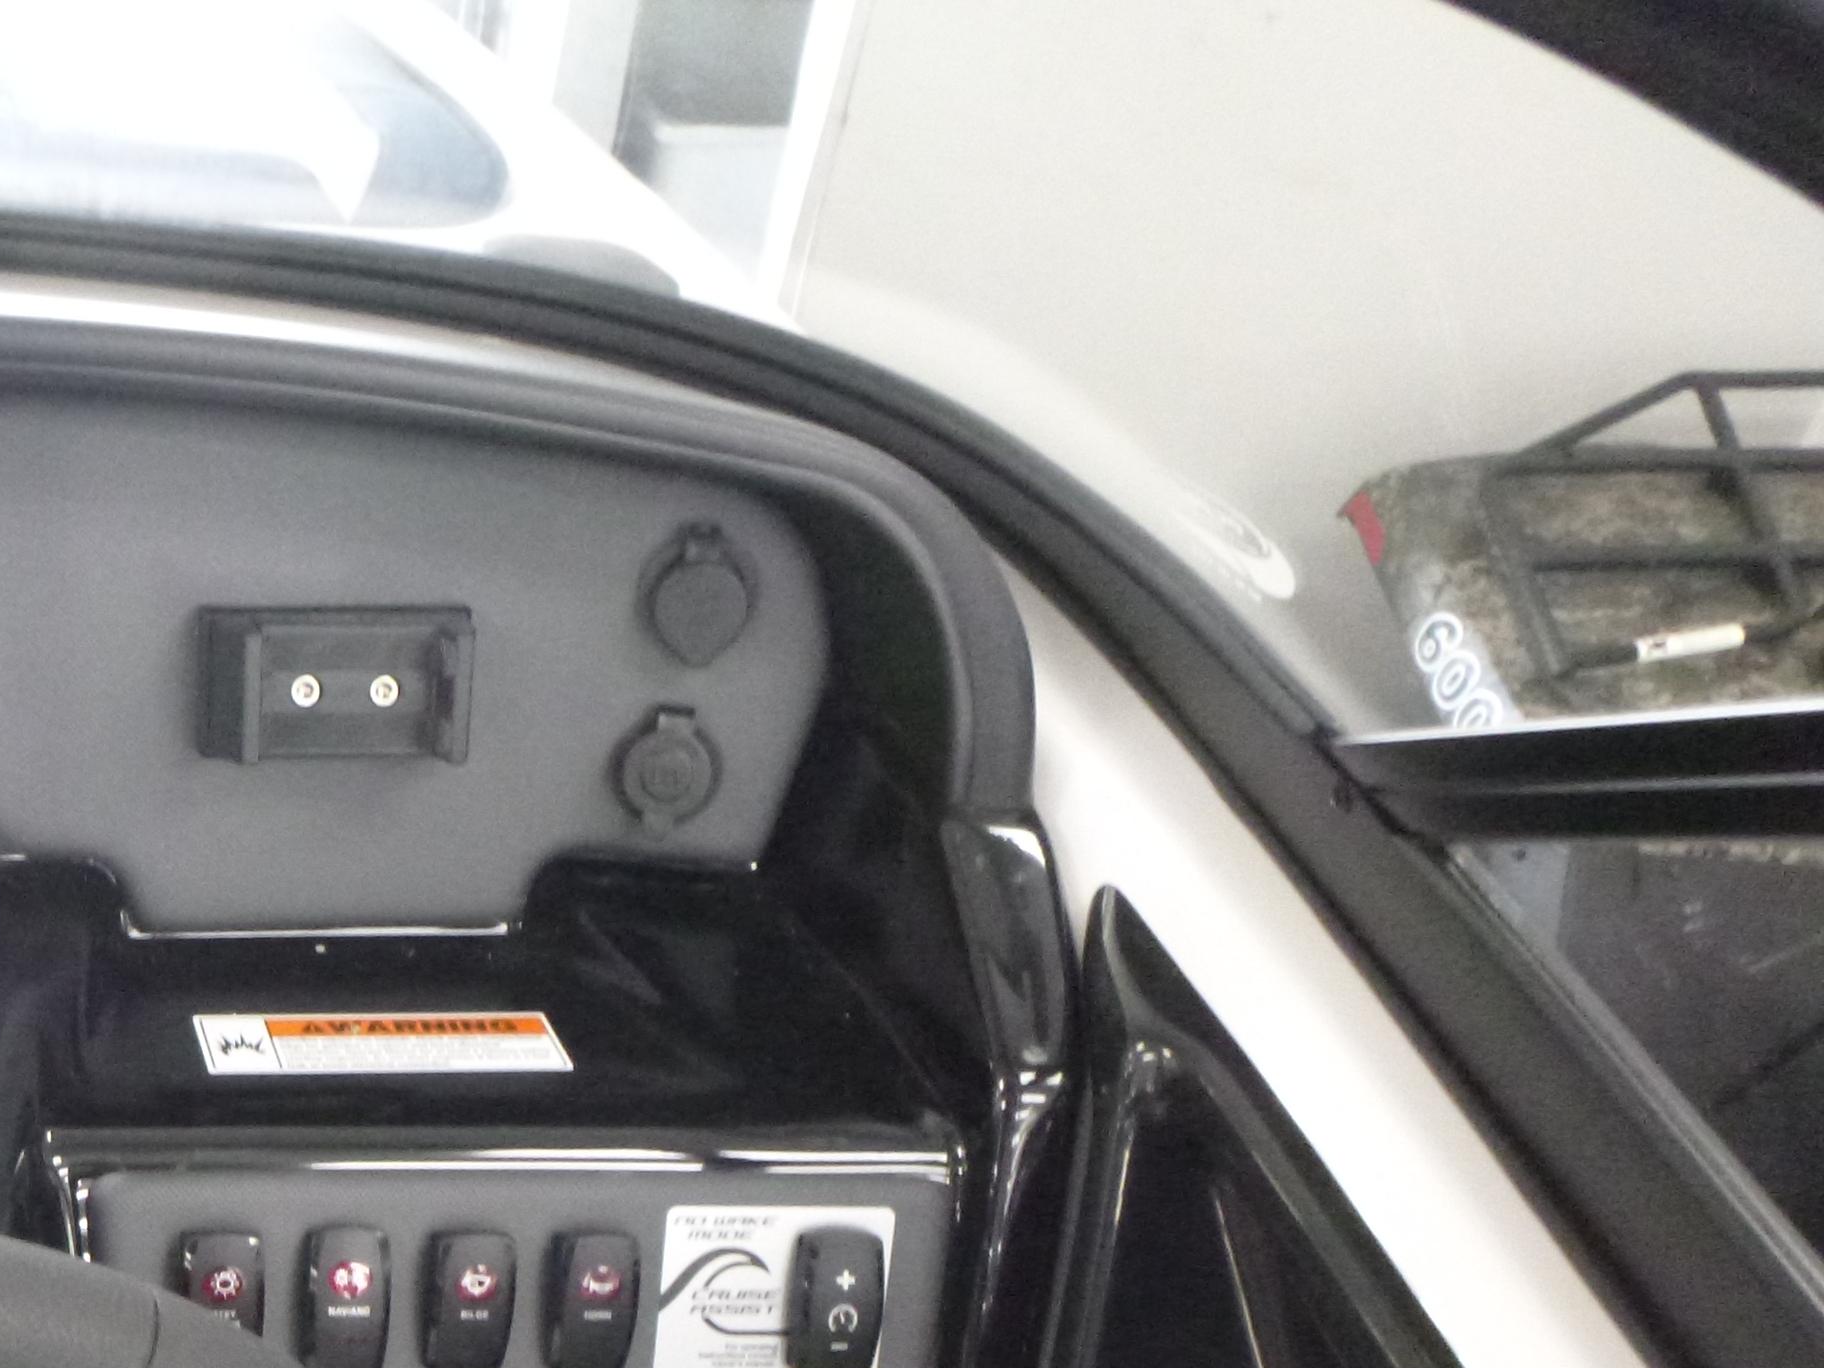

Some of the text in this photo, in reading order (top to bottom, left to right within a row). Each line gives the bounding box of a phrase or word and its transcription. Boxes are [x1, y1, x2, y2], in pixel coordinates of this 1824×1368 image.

[326, 1019, 518, 1035] WARNING
[691, 1288, 779, 1300] CRUISE
[689, 1303, 775, 1314] ASSIST
